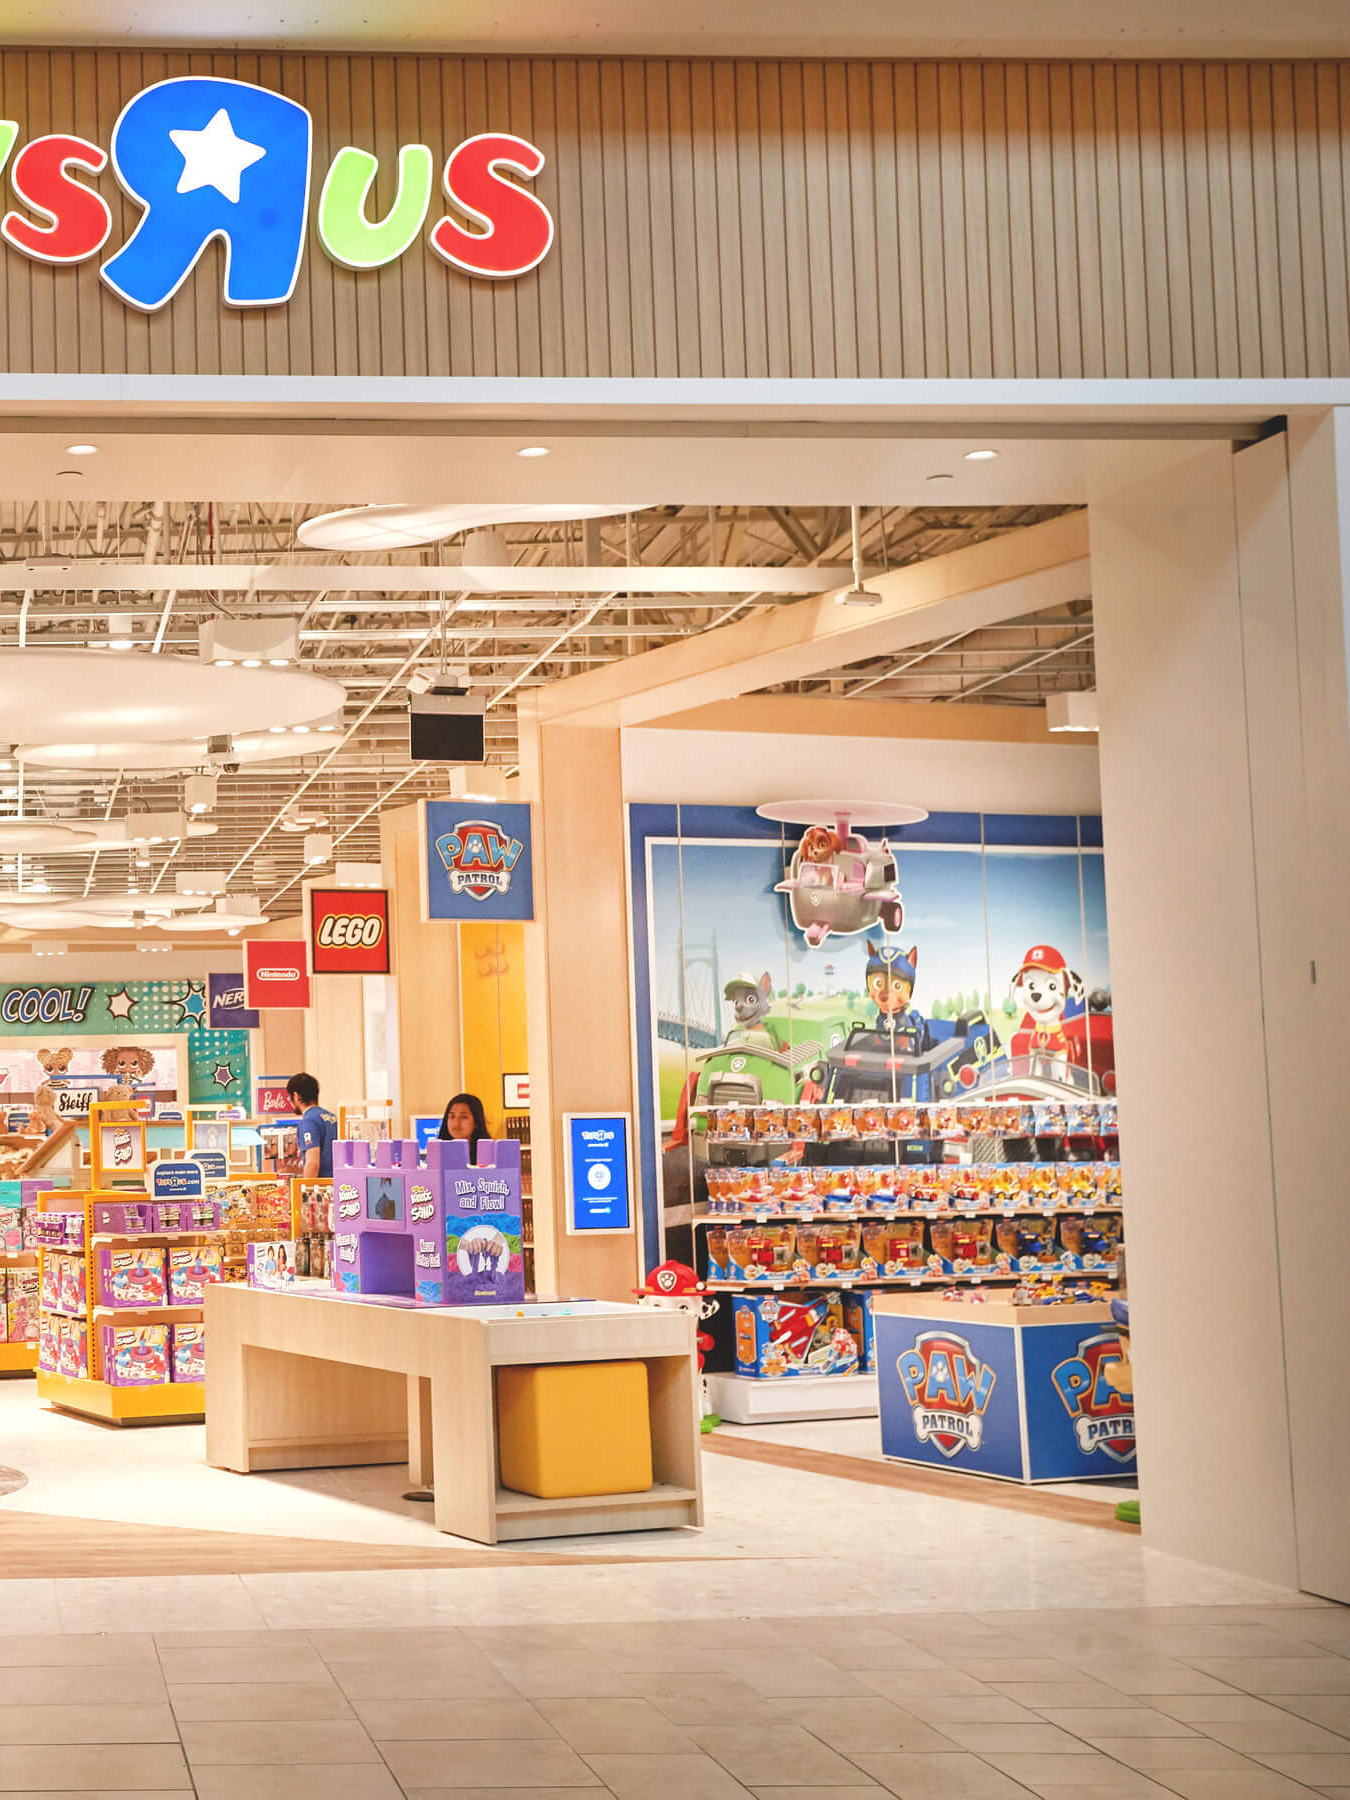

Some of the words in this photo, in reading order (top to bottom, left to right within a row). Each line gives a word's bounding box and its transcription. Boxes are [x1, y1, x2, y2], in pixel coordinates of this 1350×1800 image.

[436, 832, 523, 871] PAW
[457, 873, 502, 884] PATROL
[319, 915, 382, 947] LEGO
[1, 987, 94, 1024] COOL!
[213, 991, 244, 1008] NER
[58, 1092, 92, 1112] Steiff
[455, 1180, 476, 1194] Mix,
[477, 1177, 510, 1195] Squish,
[460, 1196, 476, 1208] and
[480, 1196, 505, 1210] Flow!
[896, 1349, 996, 1415] PAW
[1051, 1352, 1133, 1418] PA
[922, 1414, 974, 1436] PATROL
[1088, 1419, 1134, 1440] PATR
